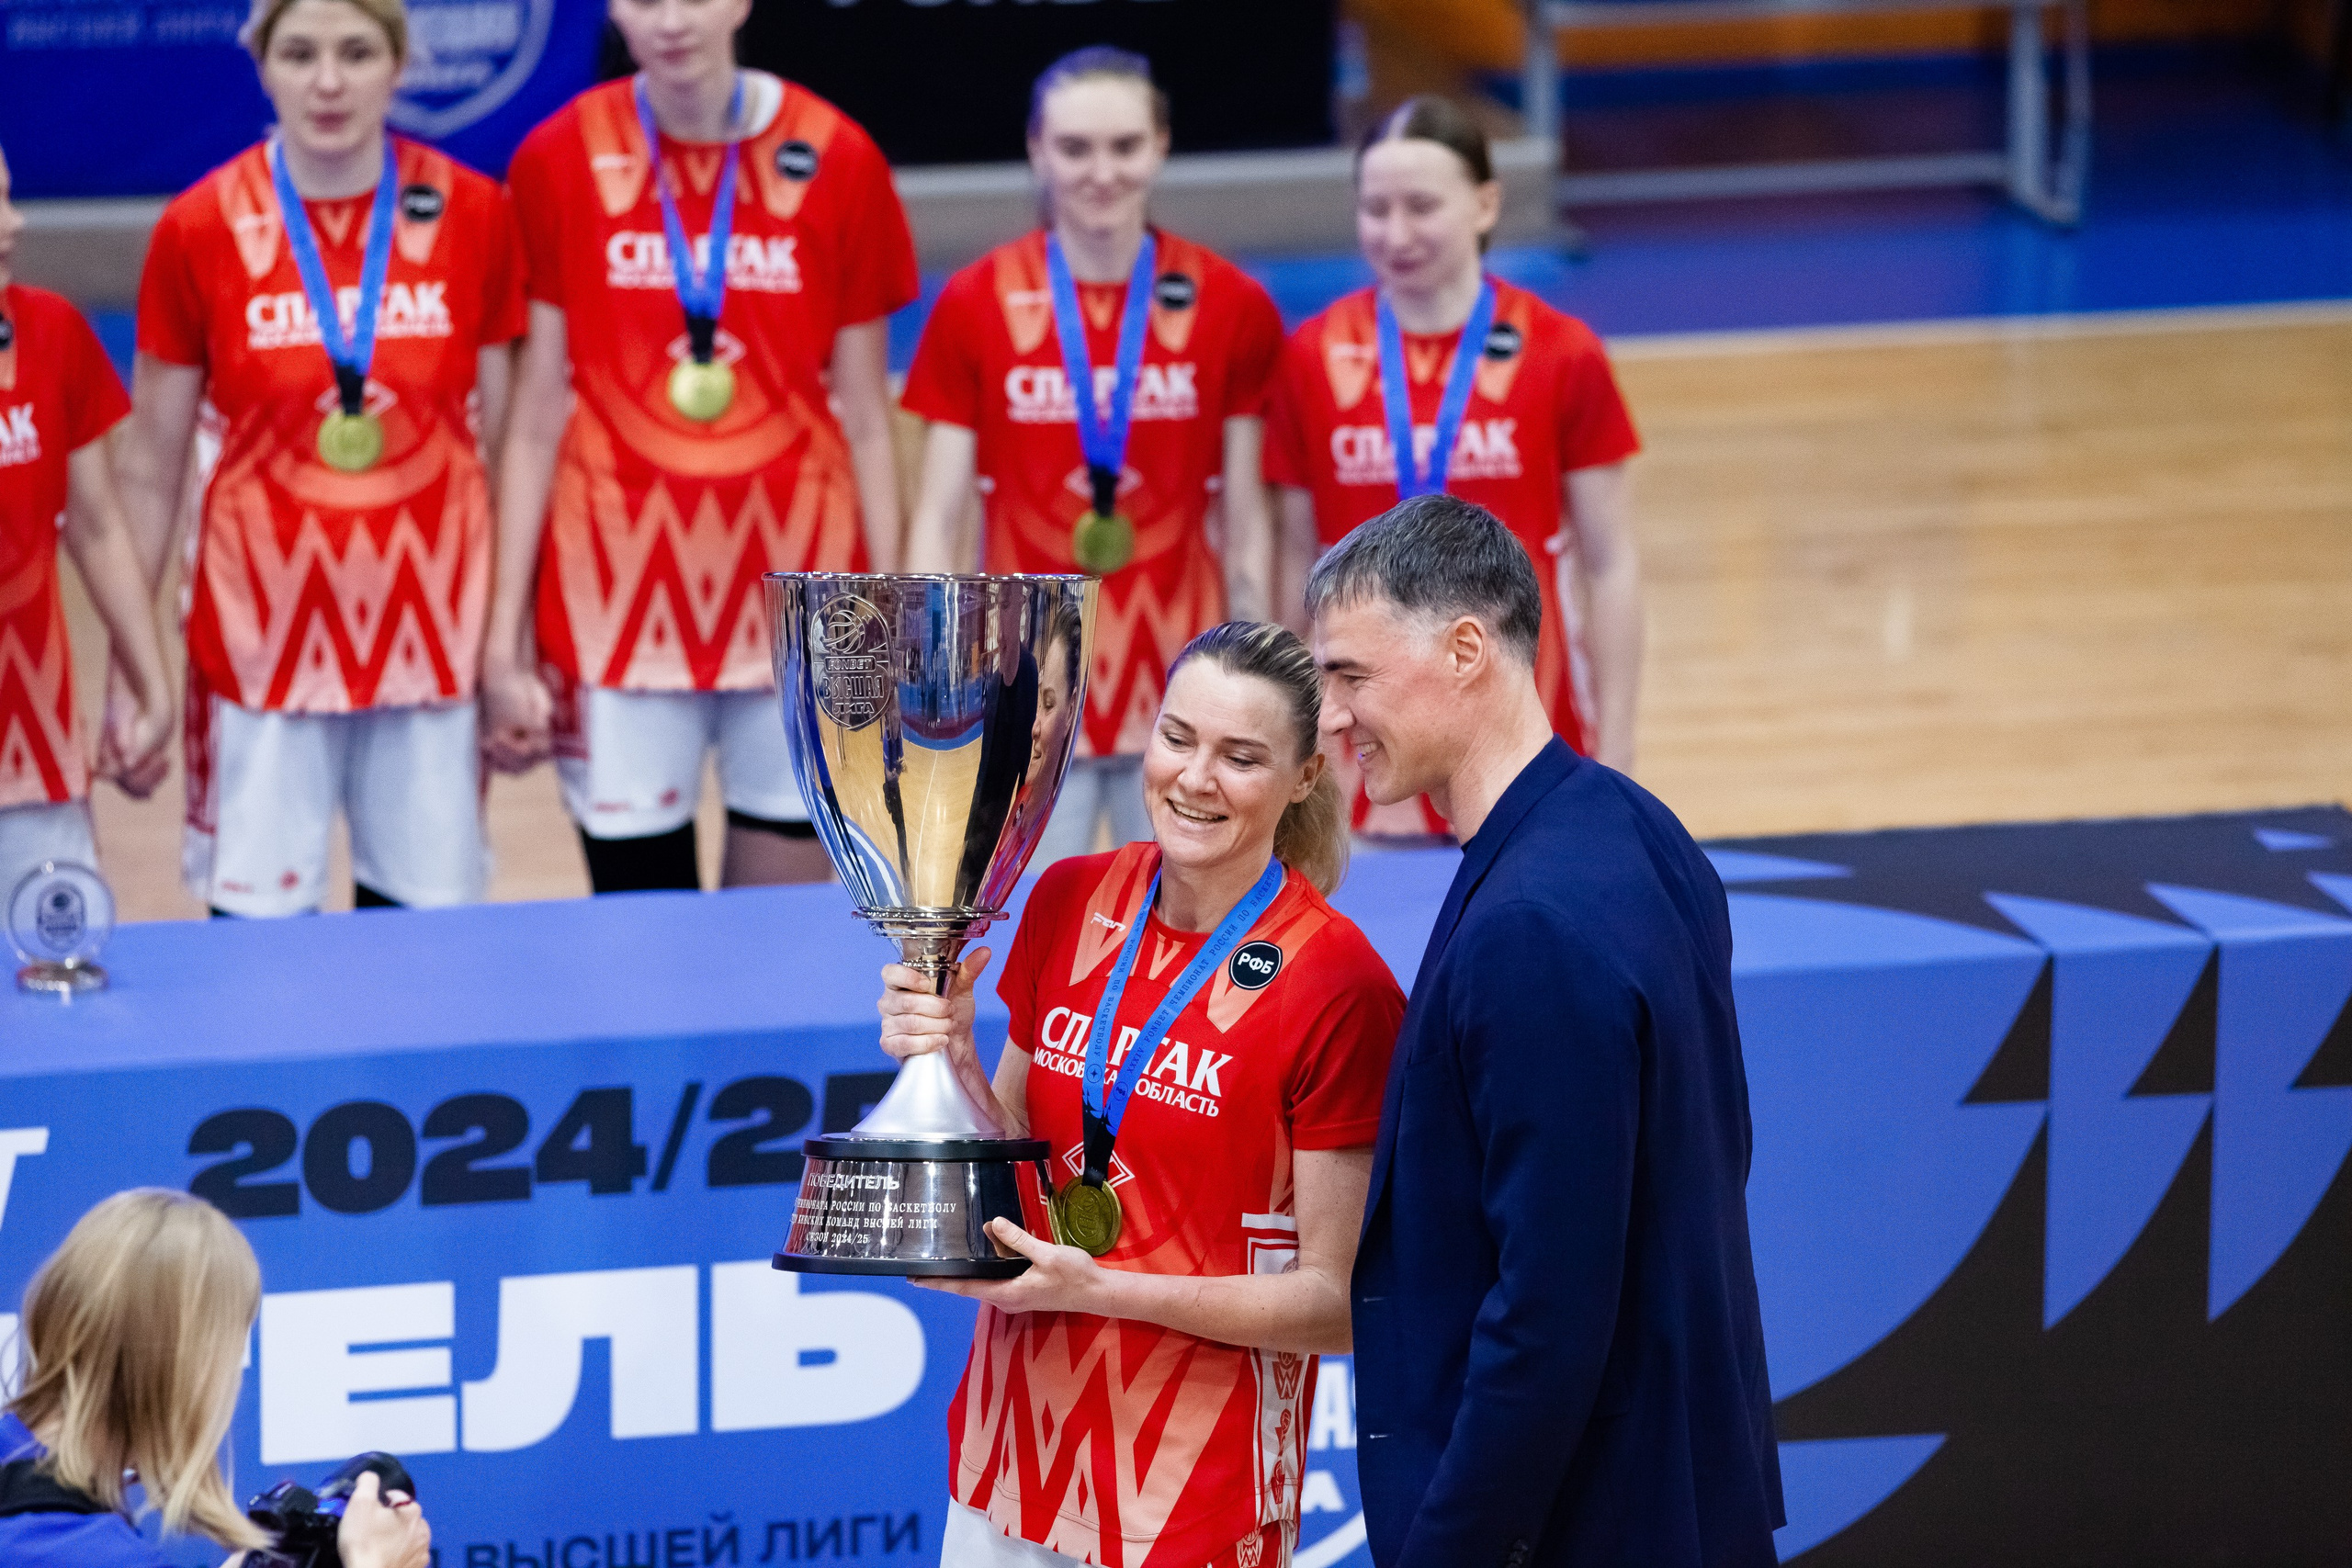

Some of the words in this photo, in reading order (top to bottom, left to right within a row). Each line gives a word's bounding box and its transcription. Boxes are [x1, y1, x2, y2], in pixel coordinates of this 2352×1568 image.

[828, 658, 872, 670] FONBET
[822, 675, 884, 698] ВЫСШАЯ
[832, 702, 875, 714] ЛИГА
[1237, 952, 1275, 975] РФБ
[1111, 978, 1121, 991] ПО
[1144, 1009, 1170, 1043] FONBET
[1169, 958, 1210, 1005] ЧЕМПИОНАТ
[1208, 923, 1238, 956] РОССИИ
[1237, 908, 1250, 922] ПО
[1093, 996, 1114, 1057] БАСКЕТБОЛУ
[1041, 1006, 1234, 1098] СПРАК
[1135, 1077, 1220, 1118] ОБЛАСТЬ
[808, 1172, 899, 1190] ПОБЕДИТЕЛЬ
[831, 1200, 865, 1212] РОССИИ
[868, 1201, 881, 1213] ПО
[826, 1216, 859, 1229] КОМАНД
[908, 1218, 938, 1229] ЛИГИ
[806, 1231, 830, 1242] СЕЗОН
[831, 1232, 870, 1245] 2024/25
[243, 1260, 925, 1464] ЕЛЬ
[760, 1512, 919, 1561] ЛИГИ
